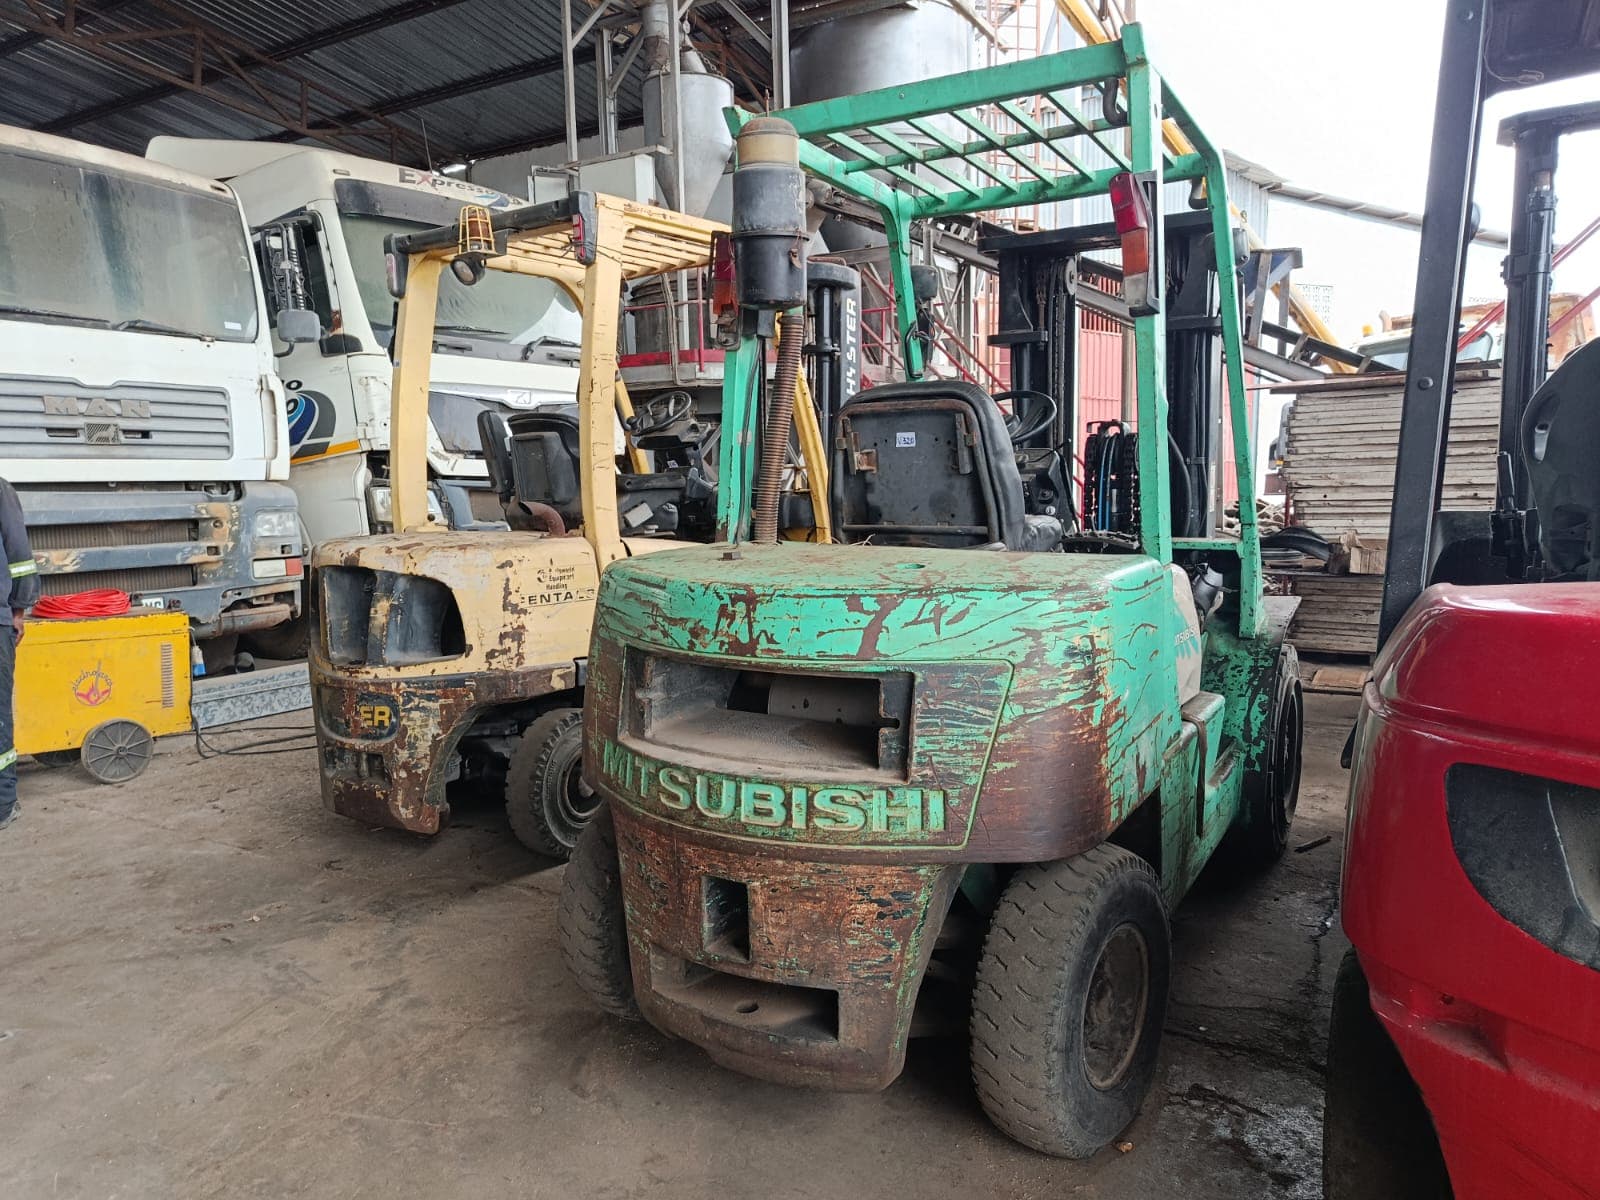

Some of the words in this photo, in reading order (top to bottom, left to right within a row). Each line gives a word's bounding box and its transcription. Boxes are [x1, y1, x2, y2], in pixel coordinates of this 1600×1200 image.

[846, 297, 856, 396] HYSTER
[43, 395, 150, 418] MAN
[602, 737, 945, 833] MITSUBISHI
